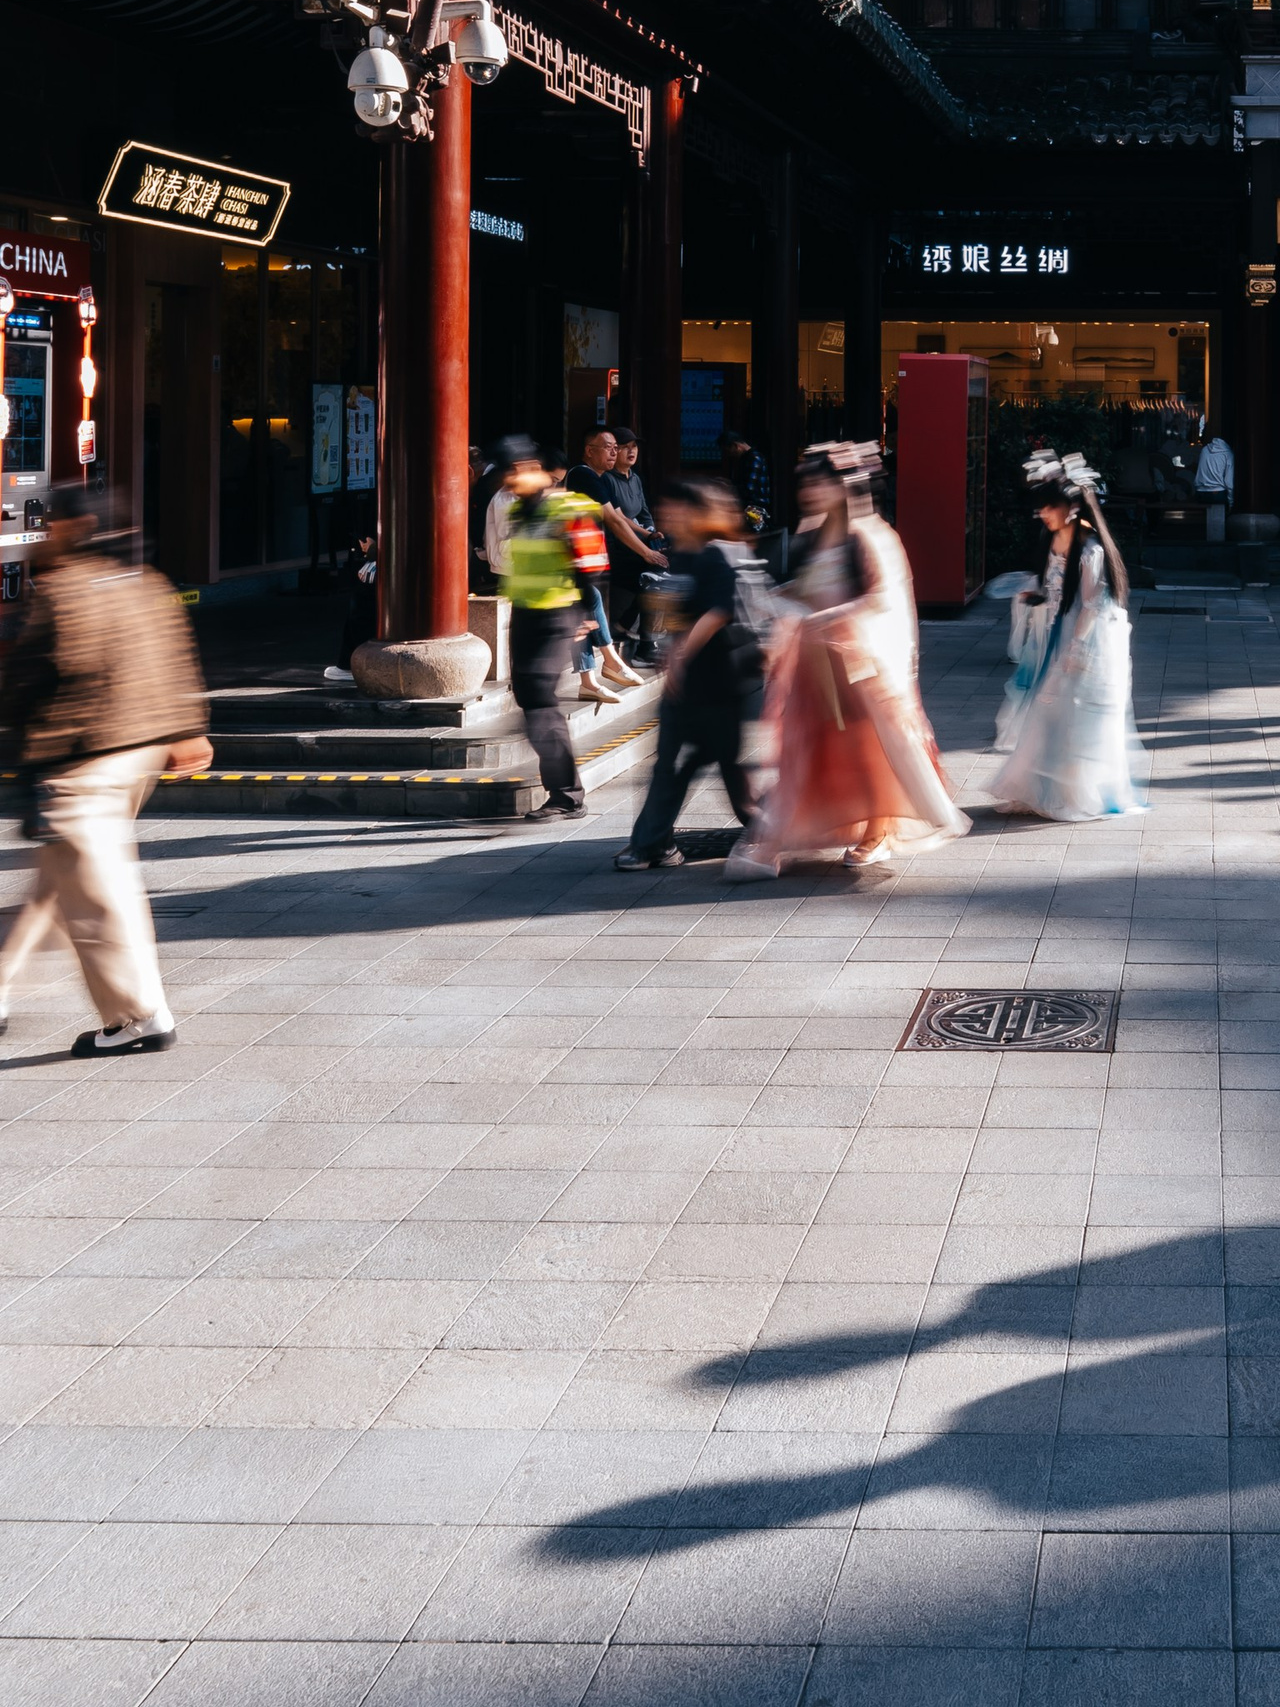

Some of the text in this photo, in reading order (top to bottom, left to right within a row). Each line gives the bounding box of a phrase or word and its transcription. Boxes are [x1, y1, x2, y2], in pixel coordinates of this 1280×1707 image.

[225, 185, 270, 206] HANCHUN
[0, 242, 68, 278] CHINA
[922, 244, 1070, 274] 绣娘丝绸
